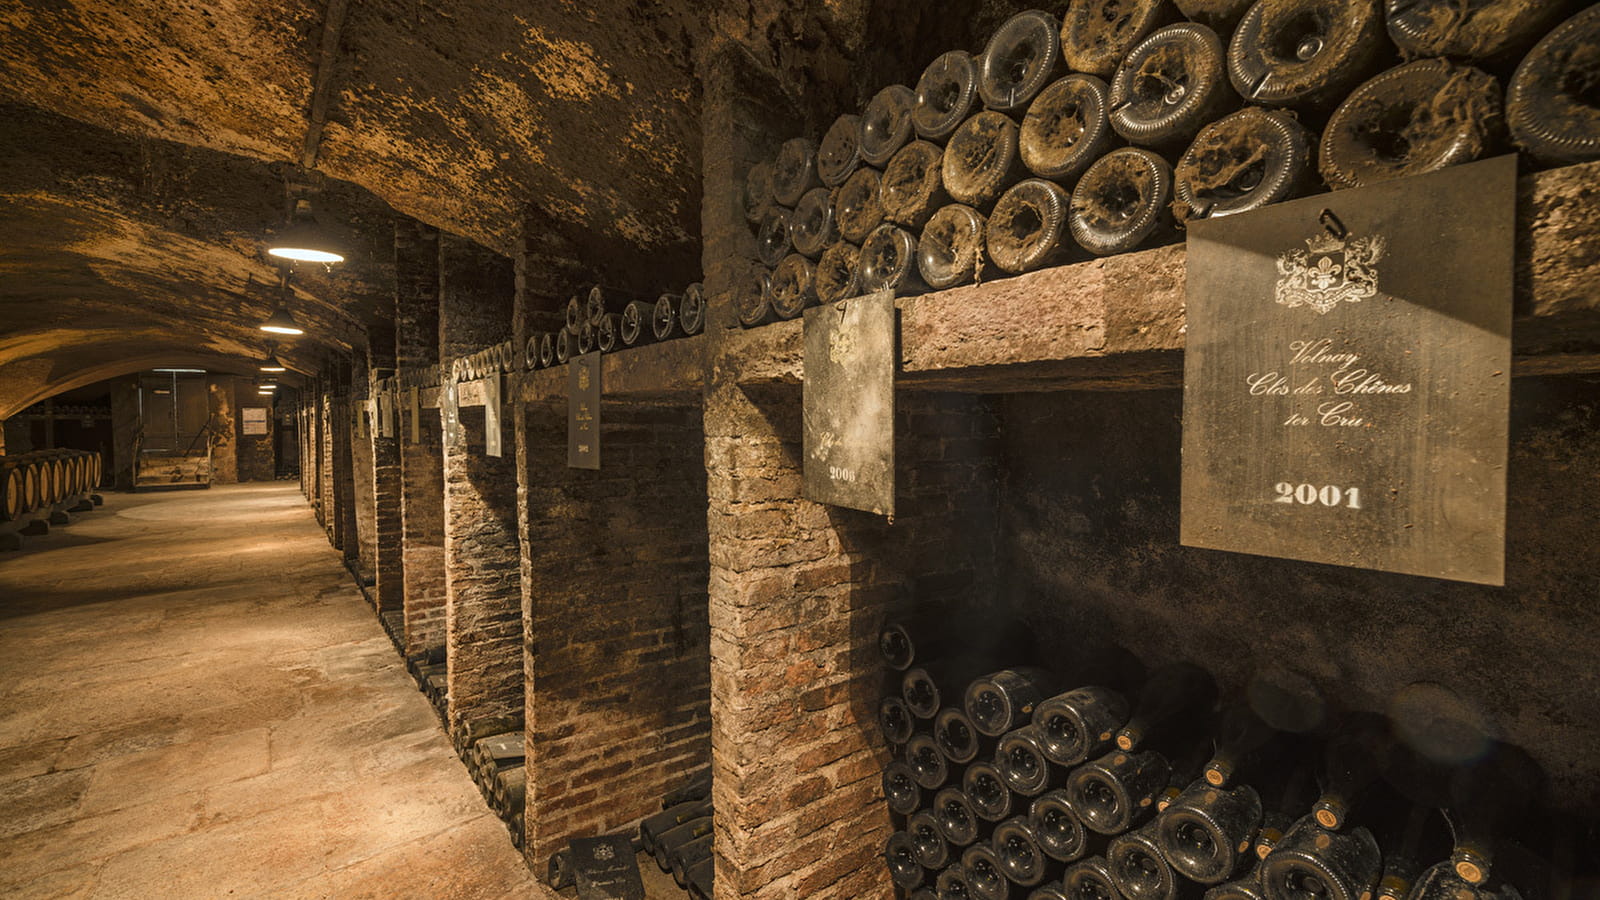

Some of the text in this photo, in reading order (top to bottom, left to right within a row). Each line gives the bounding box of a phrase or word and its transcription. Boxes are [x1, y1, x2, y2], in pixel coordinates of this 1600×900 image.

[1289, 338, 1360, 369] Volnay
[1293, 377, 1323, 395] des
[1330, 369, 1412, 395] Chênes
[1284, 401, 1363, 426] 1er Cru
[1274, 481, 1364, 510] 2001
